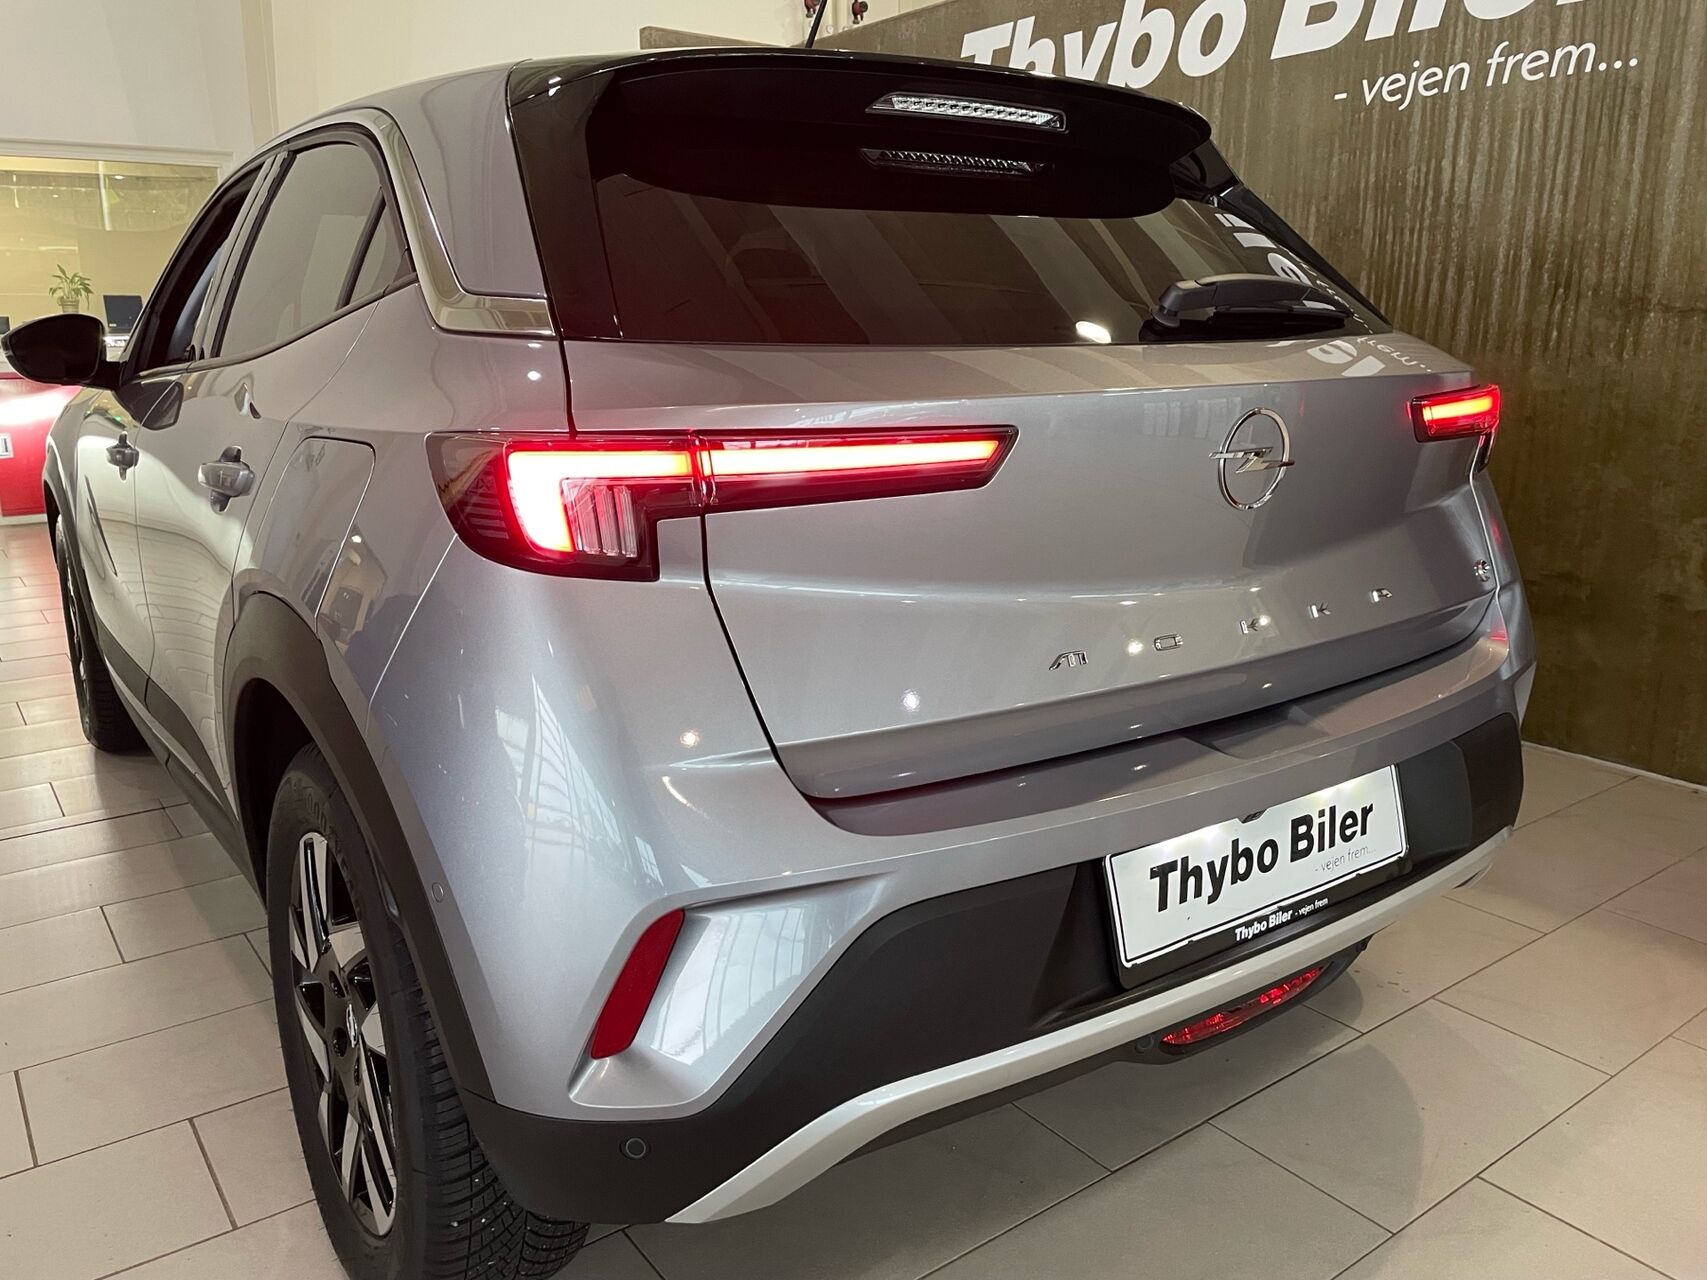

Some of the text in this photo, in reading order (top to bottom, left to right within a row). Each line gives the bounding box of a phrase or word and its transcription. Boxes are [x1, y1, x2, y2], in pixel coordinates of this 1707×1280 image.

[1361, 59, 1471, 112] vejen
[1485, 40, 1639, 88] frem...
[1149, 803, 1374, 913] Thybo Biler
[1321, 855, 1346, 875] vejen
[1234, 921, 1267, 942] Thybo
[1268, 909, 1294, 928] Biler
[1299, 903, 1314, 916] vejen
